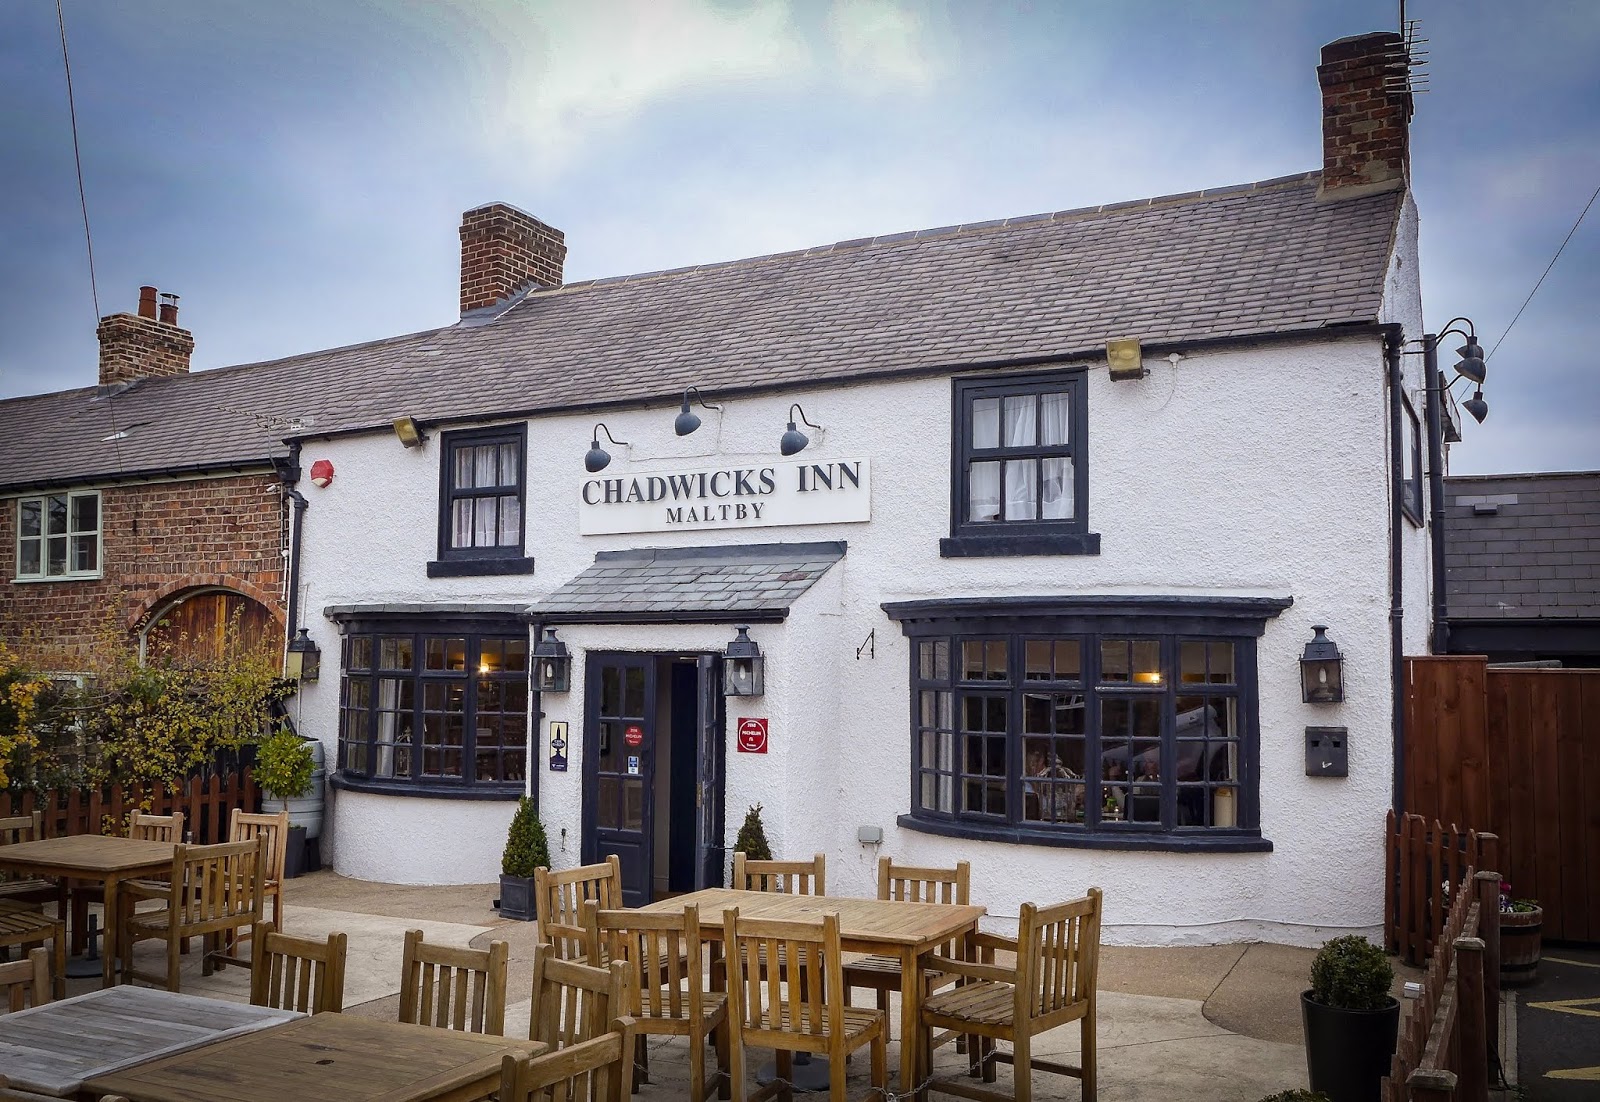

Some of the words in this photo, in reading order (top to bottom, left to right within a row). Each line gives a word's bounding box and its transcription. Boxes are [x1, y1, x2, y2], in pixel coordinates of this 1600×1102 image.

[582, 468, 776, 505] CHADWICKS
[796, 461, 862, 493] INN
[666, 503, 764, 524] MALTBY
